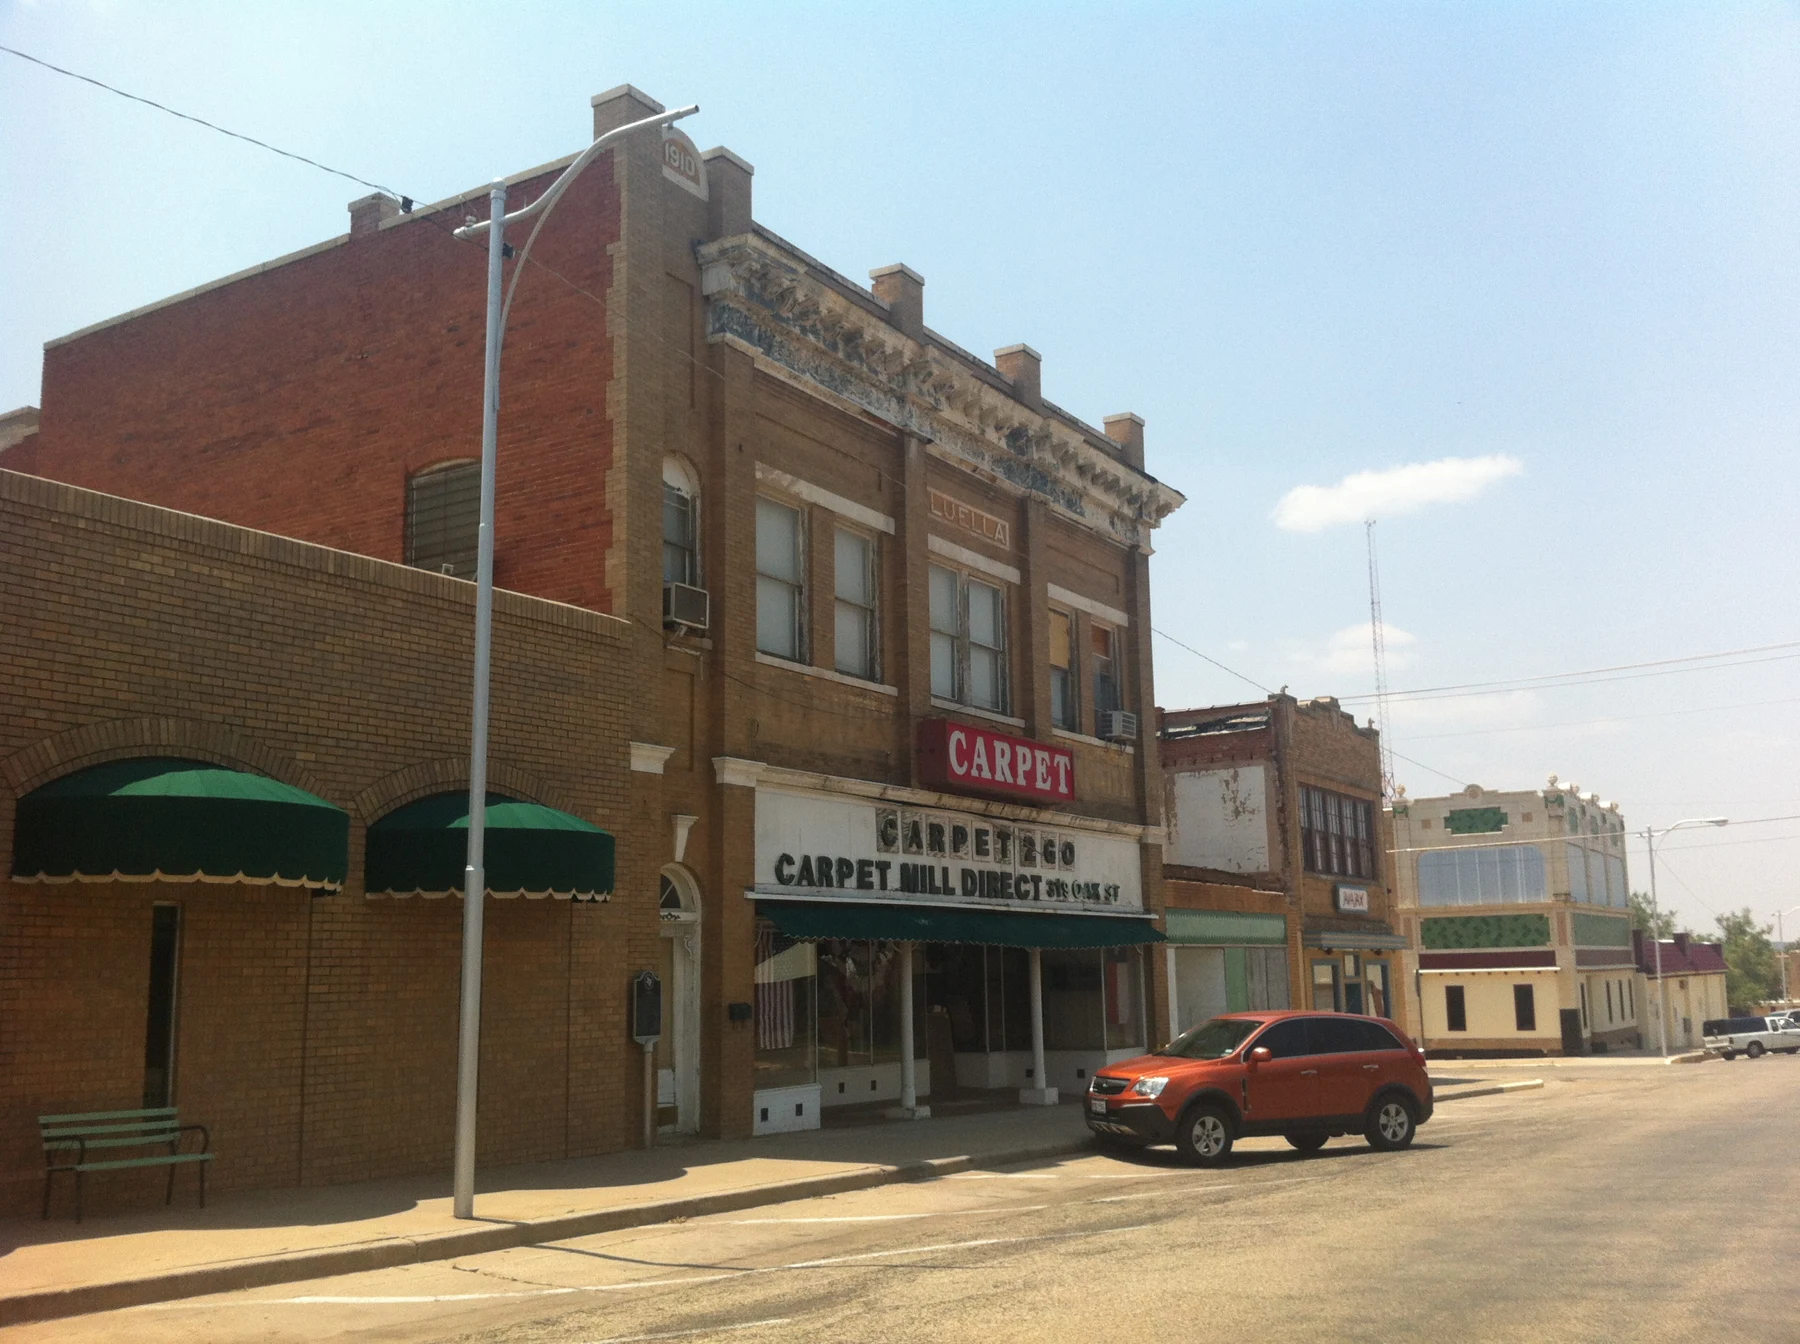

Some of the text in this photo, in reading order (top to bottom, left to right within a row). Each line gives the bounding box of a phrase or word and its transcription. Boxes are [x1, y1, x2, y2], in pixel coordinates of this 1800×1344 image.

[664, 142, 695, 176] 1910
[930, 492, 1006, 544] LUELLA
[948, 730, 1071, 794] CARPET
[880, 815, 1011, 859] CARPET
[775, 852, 892, 891] CARPET
[900, 862, 956, 896] MILL
[961, 868, 1042, 901] DIRECT
[1103, 882, 1121, 902] ST
